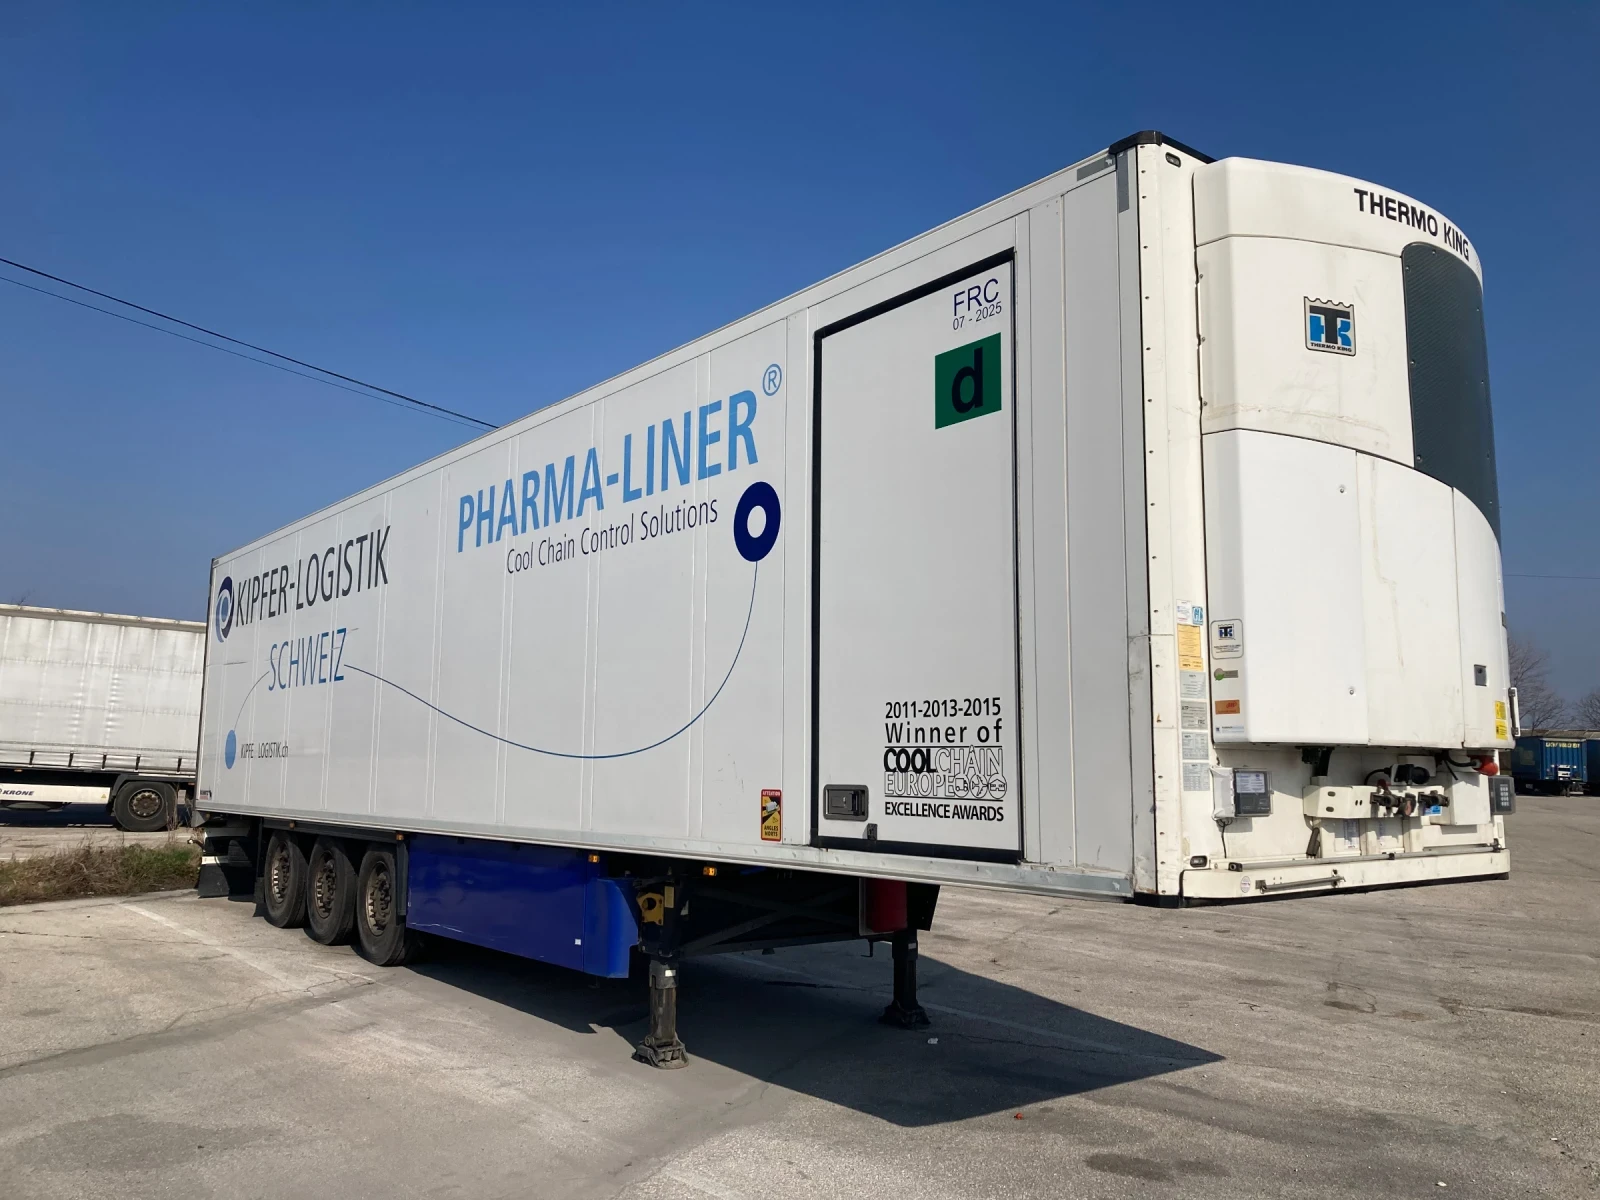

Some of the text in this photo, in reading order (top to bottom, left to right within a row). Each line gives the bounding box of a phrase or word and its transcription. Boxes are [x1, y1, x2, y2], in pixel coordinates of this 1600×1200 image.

[1354, 188, 1470, 262] THERMO KING
[952, 315, 965, 331] 07
[975, 301, 1002, 323] 2025
[953, 278, 999, 316] FRC
[1310, 342, 1336, 350] THERMO
[951, 346, 983, 414] d
[457, 389, 759, 554] PHARMA-LINER
[507, 499, 718, 575] Cool Chain Control Solutions
[235, 525, 391, 627] KIPFER-LOGISTIK
[268, 627, 347, 691] SCHWEIZ
[884, 697, 1001, 718] 2011-2013-2015
[885, 718, 1002, 743] Winner of
[884, 771, 956, 797] EUROPE
[884, 801, 1004, 821] EXCELLENCE AWARDS
